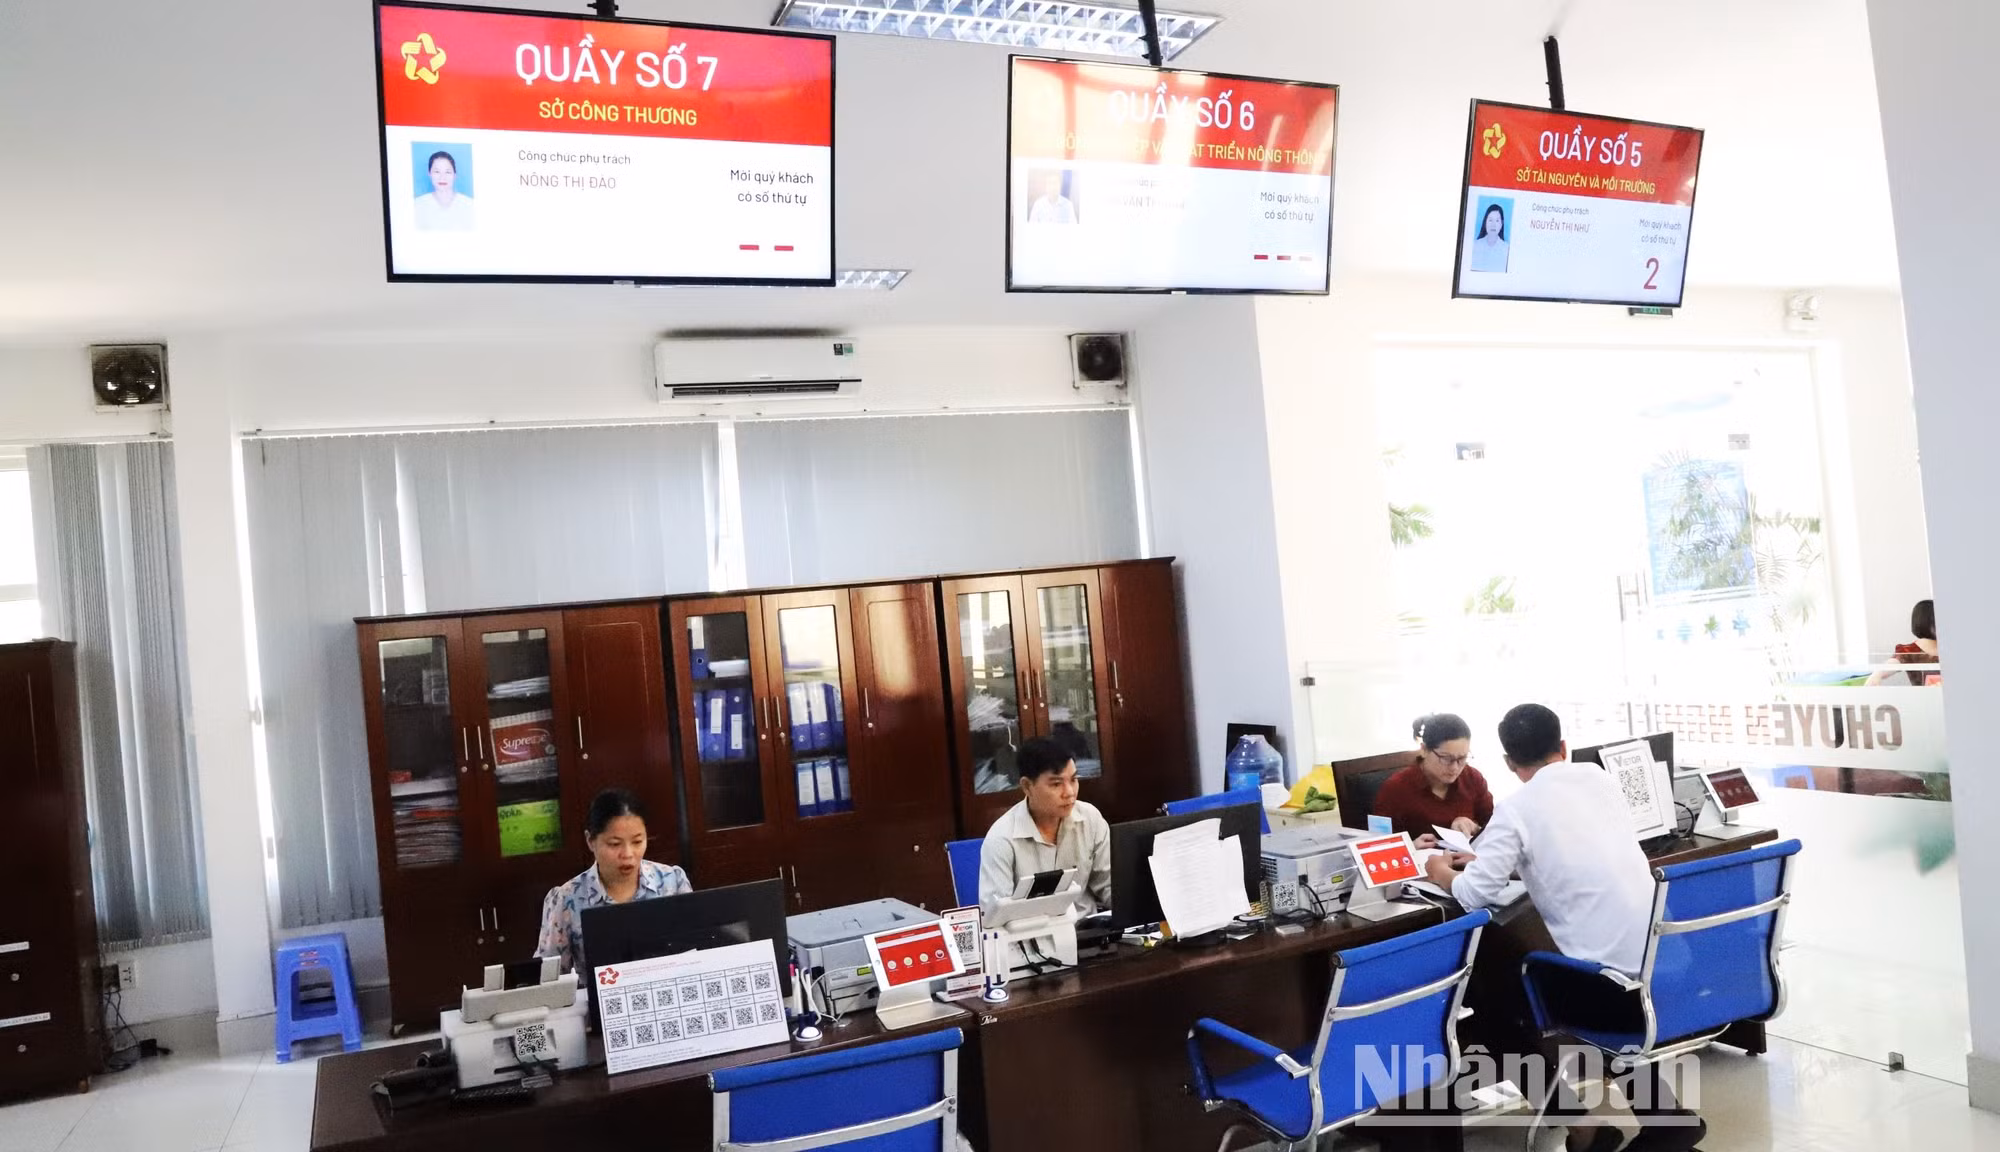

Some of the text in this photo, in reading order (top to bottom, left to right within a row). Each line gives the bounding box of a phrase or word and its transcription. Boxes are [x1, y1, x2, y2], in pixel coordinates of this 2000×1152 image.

[515, 33, 719, 91] QUẦY SỐ 7
[538, 97, 697, 126] SỞ CÔNG THƯƠNG
[1199, 90, 1233, 129] SỐ
[1238, 101, 1255, 131] 6
[518, 149, 547, 163] Công
[579, 153, 600, 166] phụ
[602, 154, 631, 165] trách
[1207, 139, 1245, 161] TRIỂN
[1247, 145, 1282, 164] NÔNG
[1539, 125, 1643, 167] QUẦY SỐ 5
[519, 172, 559, 188] NÔNG
[563, 175, 585, 191] THỊ
[730, 169, 751, 182] Mời
[778, 171, 814, 185] khách
[1516, 167, 1656, 195] SỞ TÀI NGUYÊN VÀ MÔI TRƯỜNG
[755, 190, 770, 203] số
[772, 192, 792, 204] thứ
[1643, 257, 1660, 290] 2
